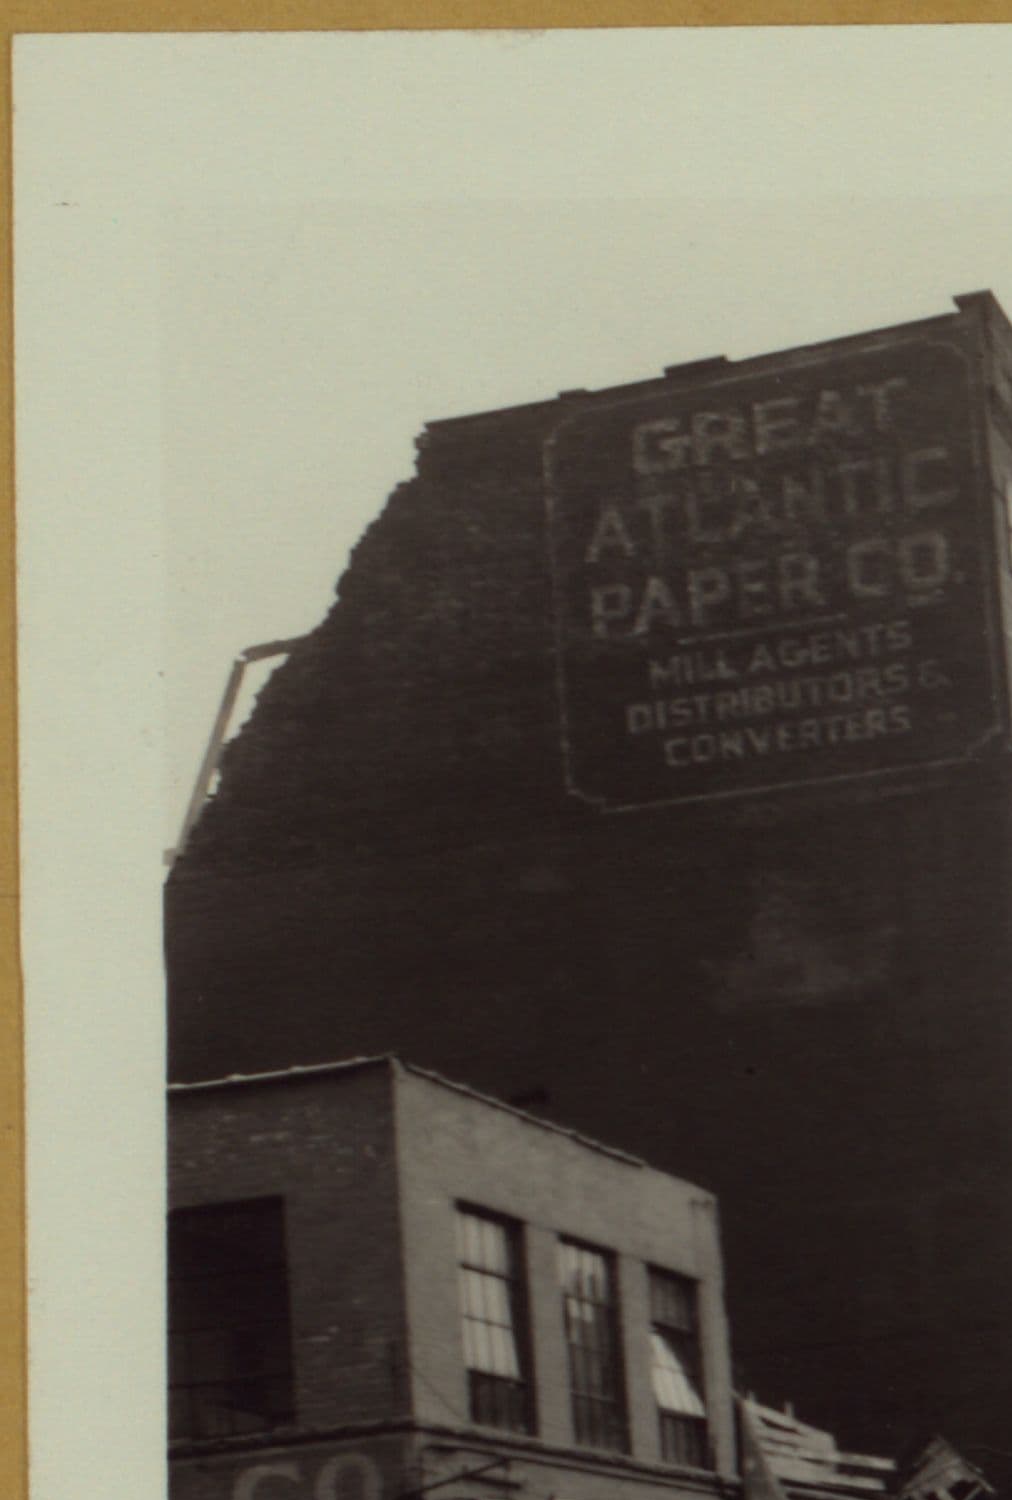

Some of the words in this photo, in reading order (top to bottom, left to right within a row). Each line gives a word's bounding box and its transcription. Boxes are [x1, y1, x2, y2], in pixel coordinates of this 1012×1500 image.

[632, 377, 908, 475] GREAT
[584, 447, 958, 563] ATLANTIC
[590, 552, 826, 640] PAPER
[648, 648, 738, 690] MILL
[748, 620, 912, 675] AGENTS
[625, 663, 911, 735] DISTRIBUTORS
[664, 704, 912, 768] CONVERTERS
